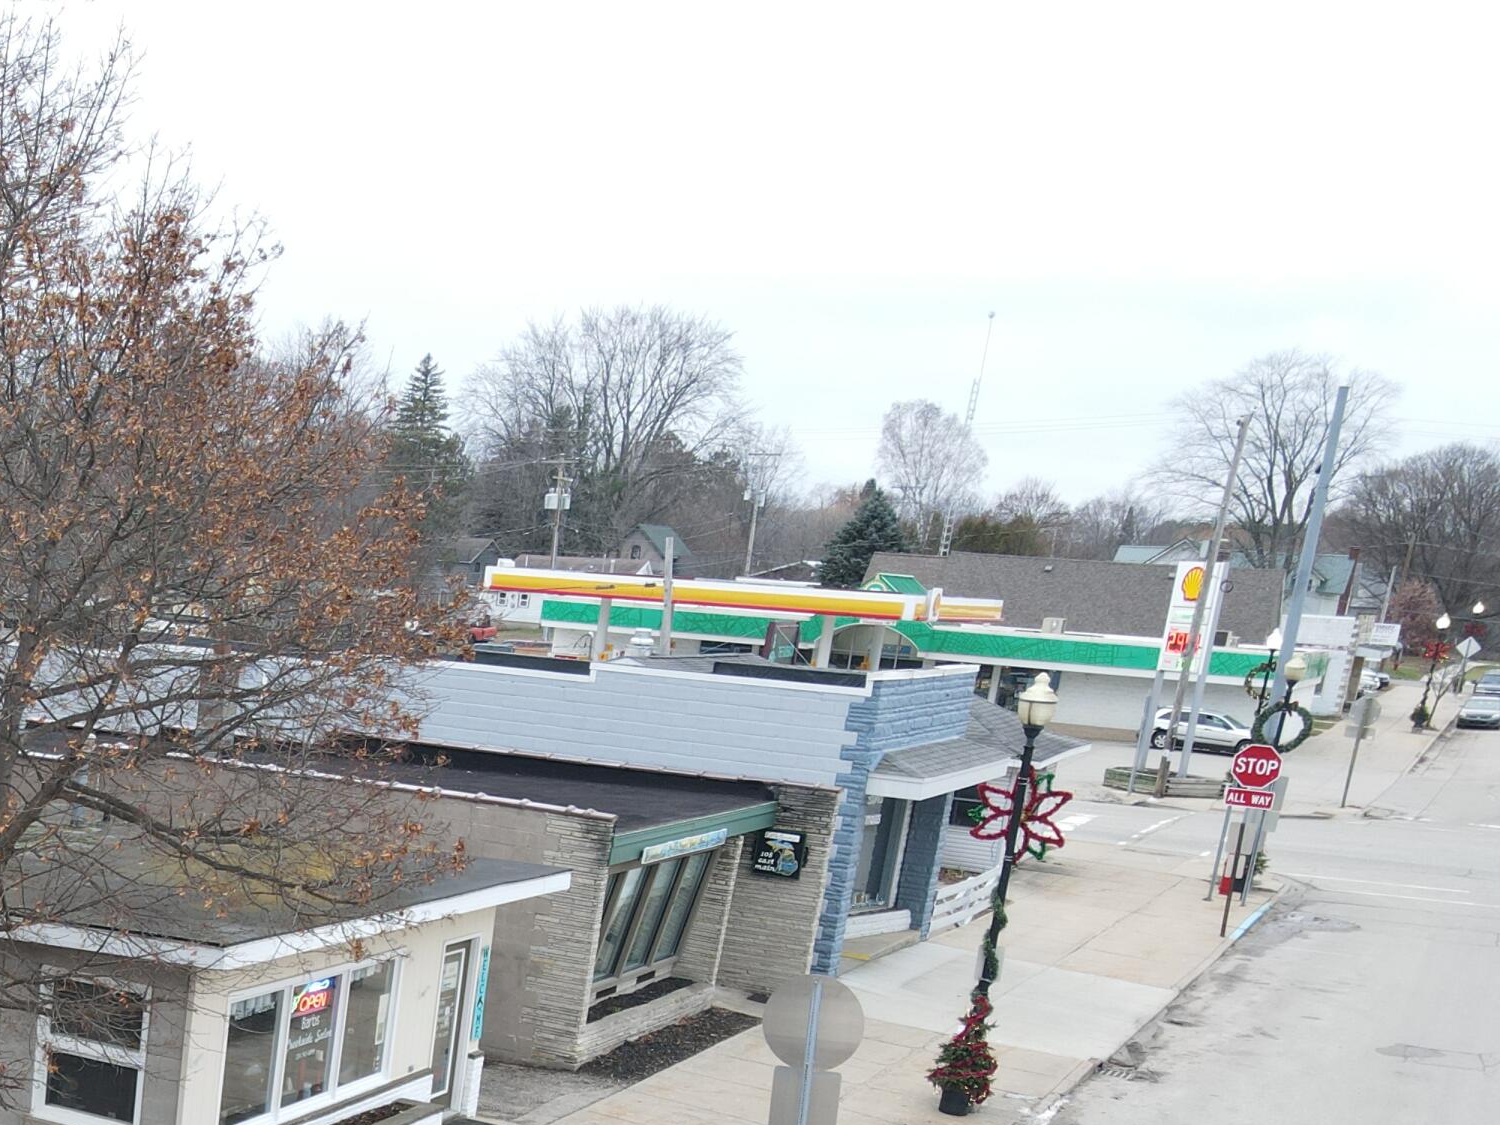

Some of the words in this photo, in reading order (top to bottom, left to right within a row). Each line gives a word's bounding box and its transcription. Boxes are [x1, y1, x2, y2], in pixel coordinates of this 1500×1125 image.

[1235, 756, 1279, 776] STOP
[1227, 792, 1246, 804] ALL
[1251, 794, 1272, 807] WAY
[299, 991, 328, 1012] OPEN
